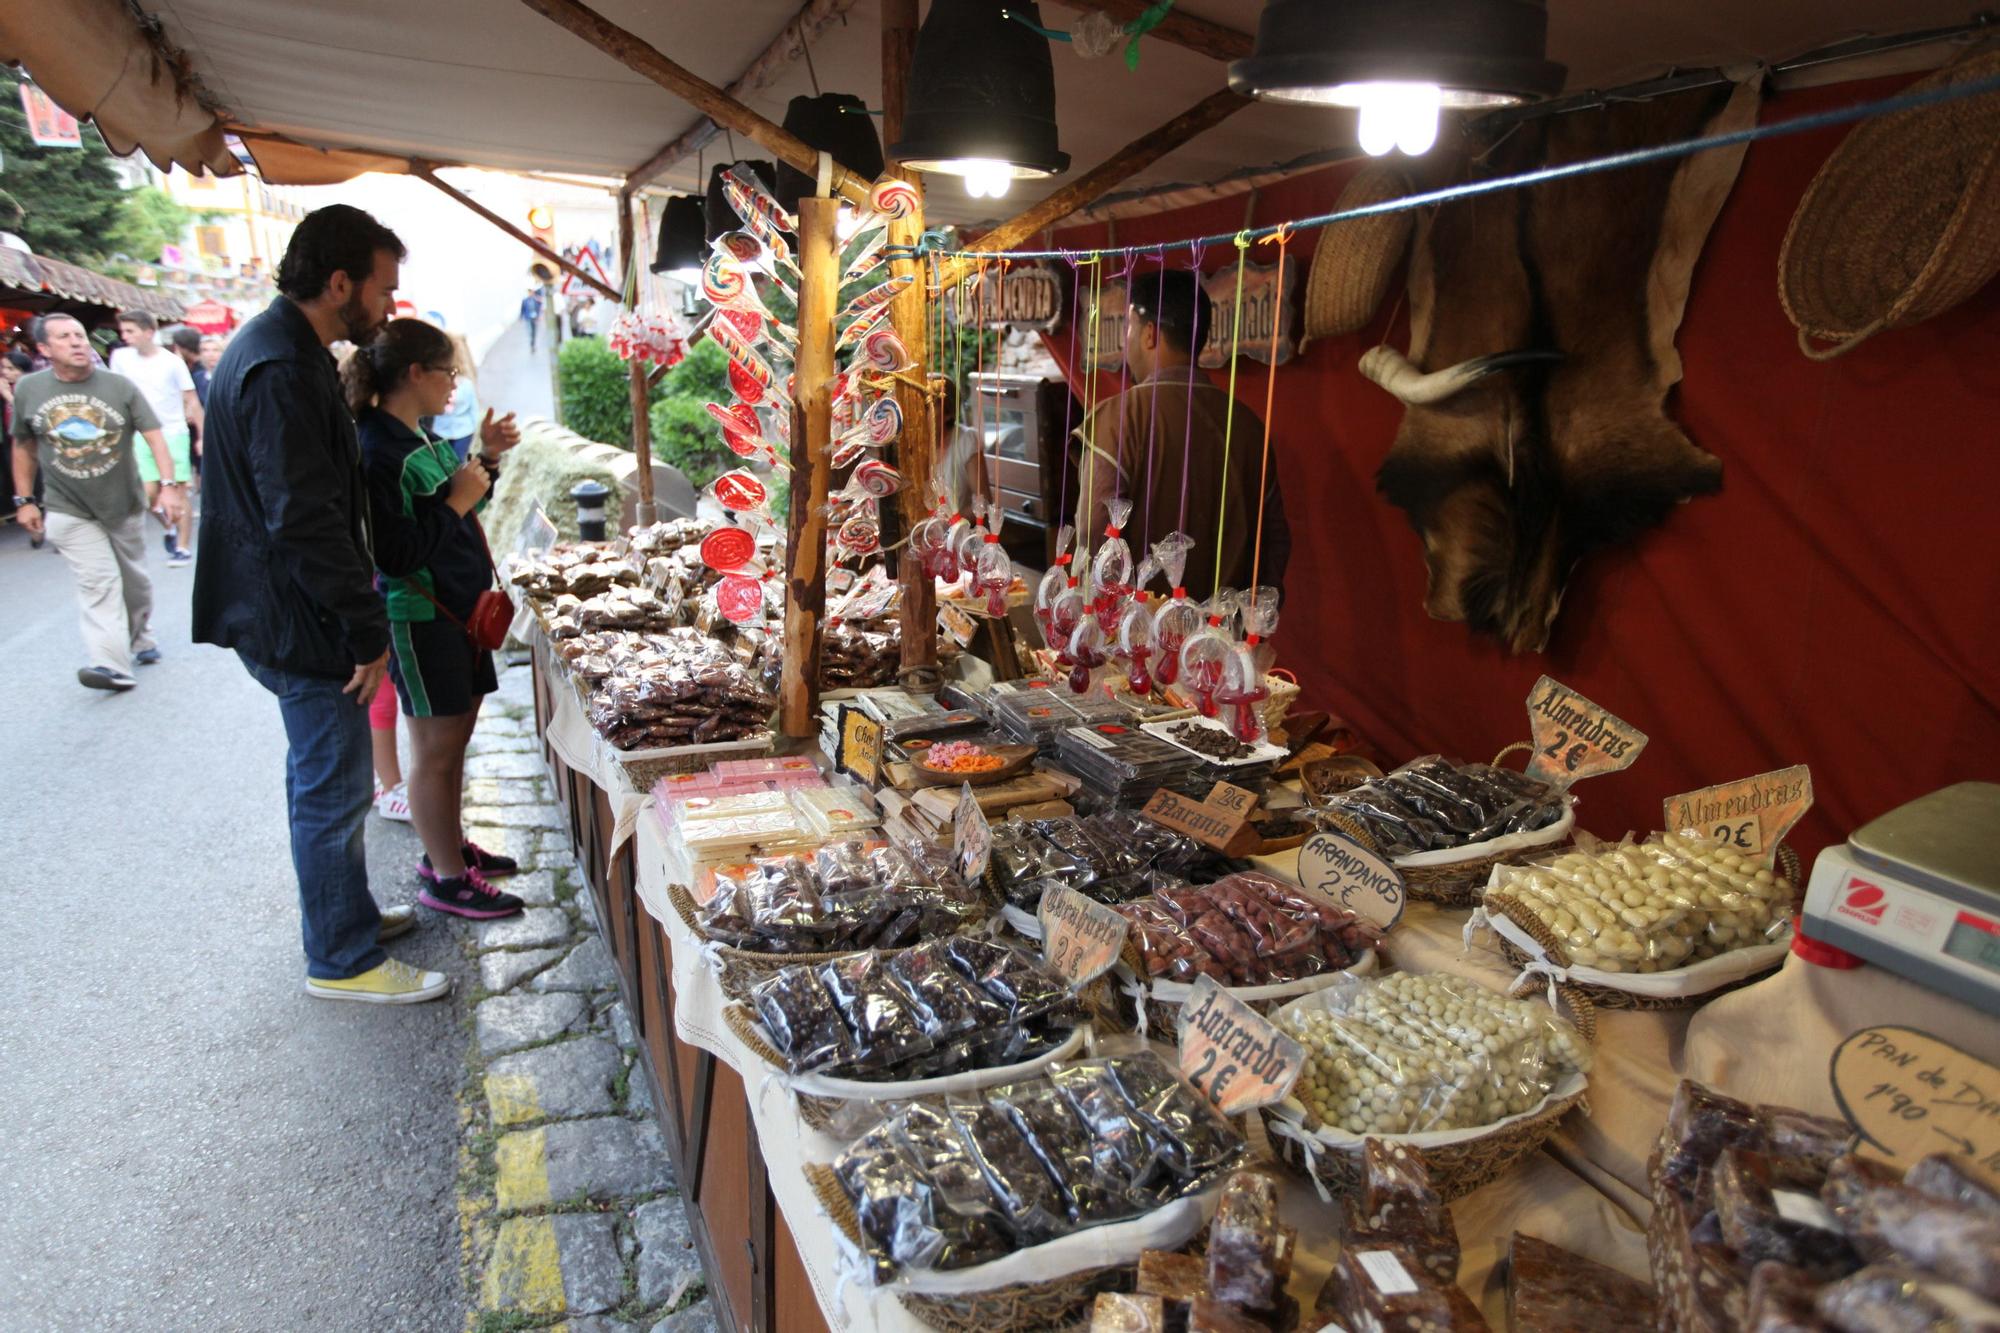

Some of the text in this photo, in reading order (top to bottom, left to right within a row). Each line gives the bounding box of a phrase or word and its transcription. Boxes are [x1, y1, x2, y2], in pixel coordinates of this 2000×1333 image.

[1533, 688, 1633, 759] Almendras
[1545, 731, 1588, 771] 2€
[1151, 792, 1232, 838] Naranja
[1679, 779, 1803, 827] Almendras
[1307, 837, 1401, 904] ARANDANOS
[1186, 990, 1287, 1085] Anacardo
[1856, 1032, 1919, 1068] PAN
[1915, 1066, 1947, 1090] de
[1189, 1048, 1238, 1104] 2€
